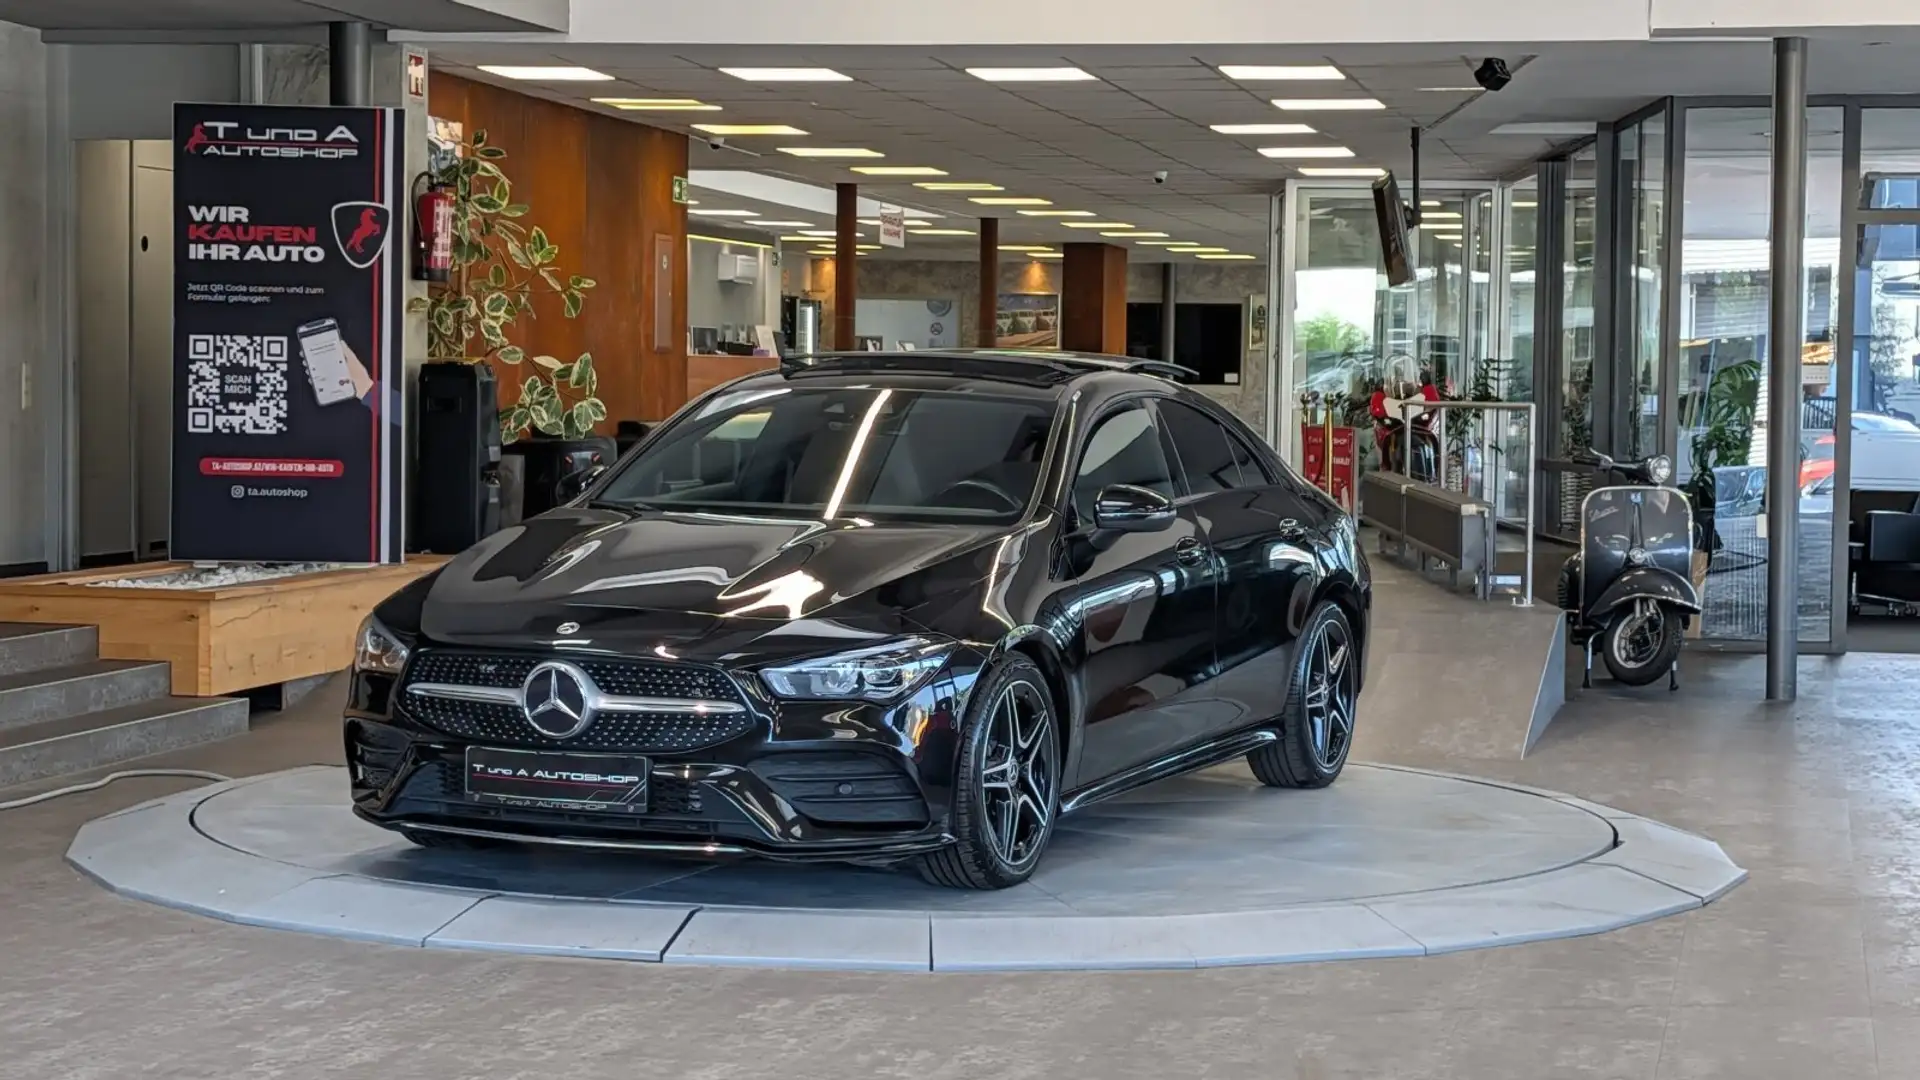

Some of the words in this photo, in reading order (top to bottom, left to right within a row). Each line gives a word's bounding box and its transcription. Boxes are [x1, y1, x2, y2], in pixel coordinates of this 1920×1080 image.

[203, 121, 239, 139] T
[324, 125, 359, 143] A
[203, 145, 359, 159] AUTOSHOP
[188, 205, 249, 223] WIR
[188, 224, 317, 243] KAUFEN
[188, 243, 240, 261] IHR
[243, 245, 326, 263] AUTO
[187, 283, 208, 293] Jetzt
[210, 283, 224, 294] QR
[225, 284, 247, 293] Code
[249, 285, 285, 294] scannen
[286, 285, 304, 294] und
[305, 287, 324, 295] zum
[187, 292, 226, 301] Formular
[224, 374, 252, 384] SCAN
[224, 385, 252, 395] MICH
[247, 486, 308, 498] ta.autoshop
[472, 763, 484, 773] T
[517, 768, 528, 777] A
[533, 770, 639, 784] AUTOSHOP
[536, 800, 607, 811] AUTOSHOP
